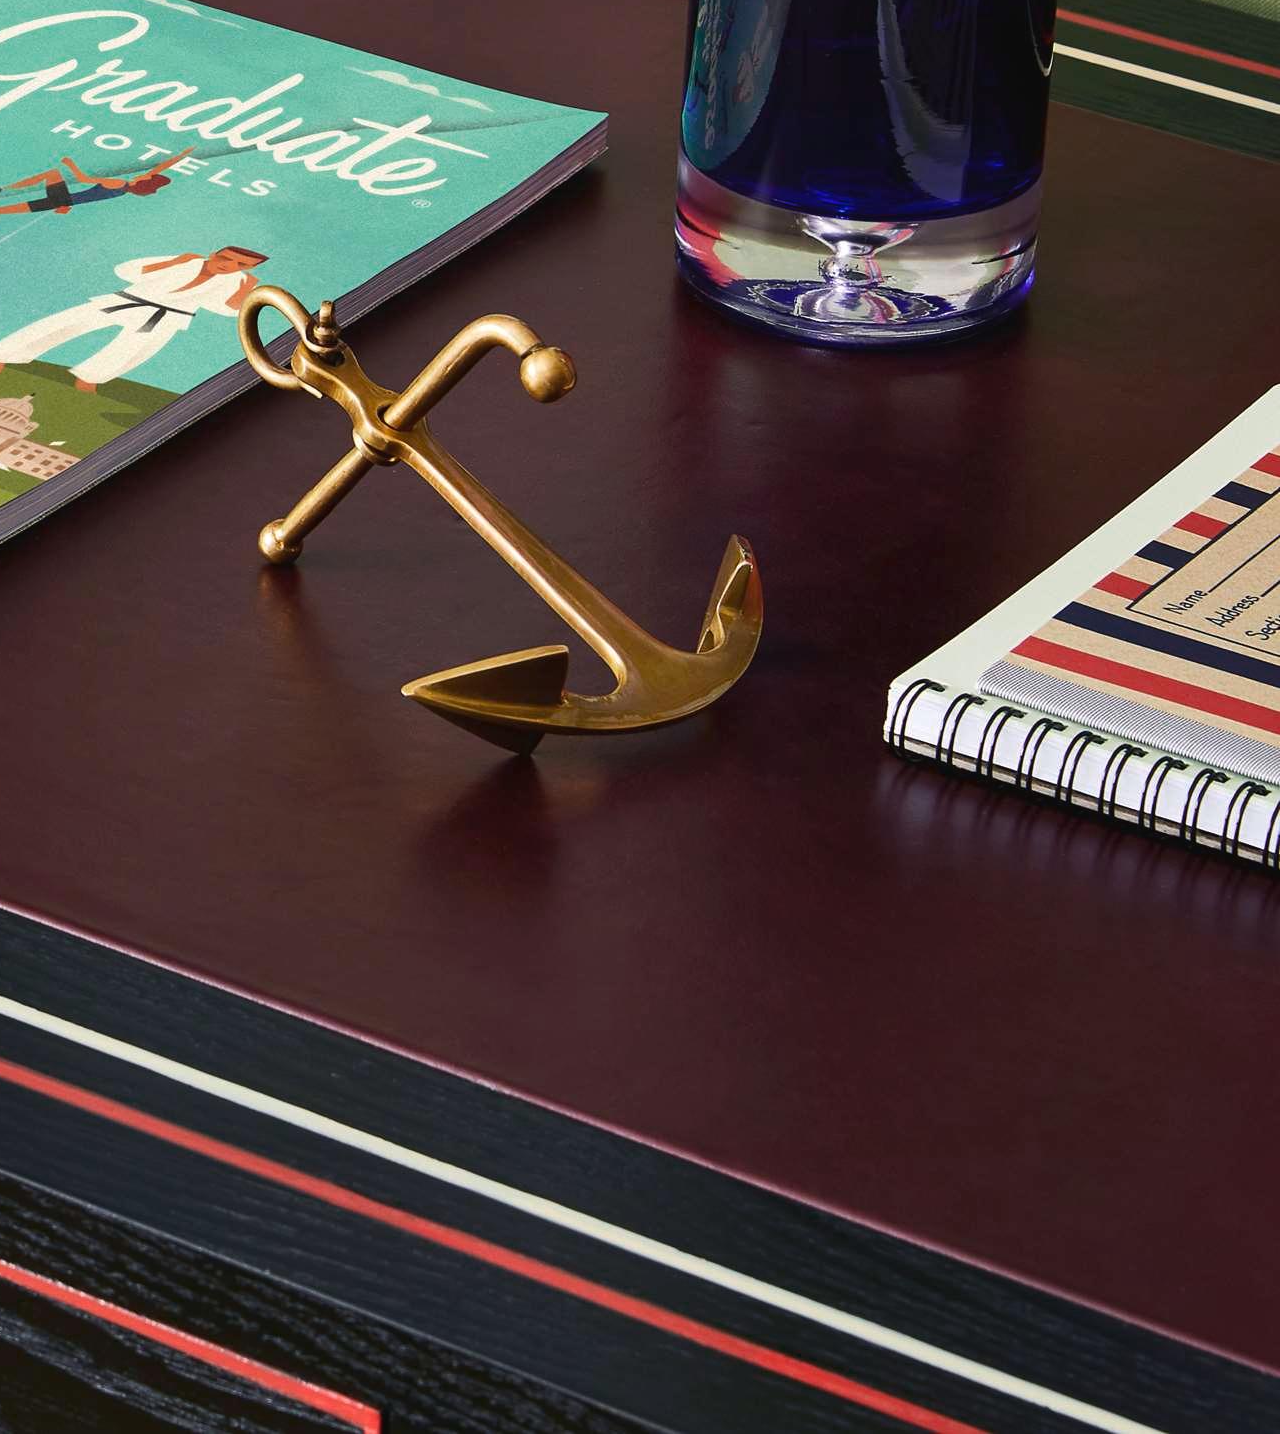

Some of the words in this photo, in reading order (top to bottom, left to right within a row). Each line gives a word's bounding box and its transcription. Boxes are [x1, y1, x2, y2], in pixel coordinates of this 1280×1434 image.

[49, 118, 279, 197] HOTELS
[1162, 589, 1208, 615] Name
[1204, 594, 1260, 628] Address
